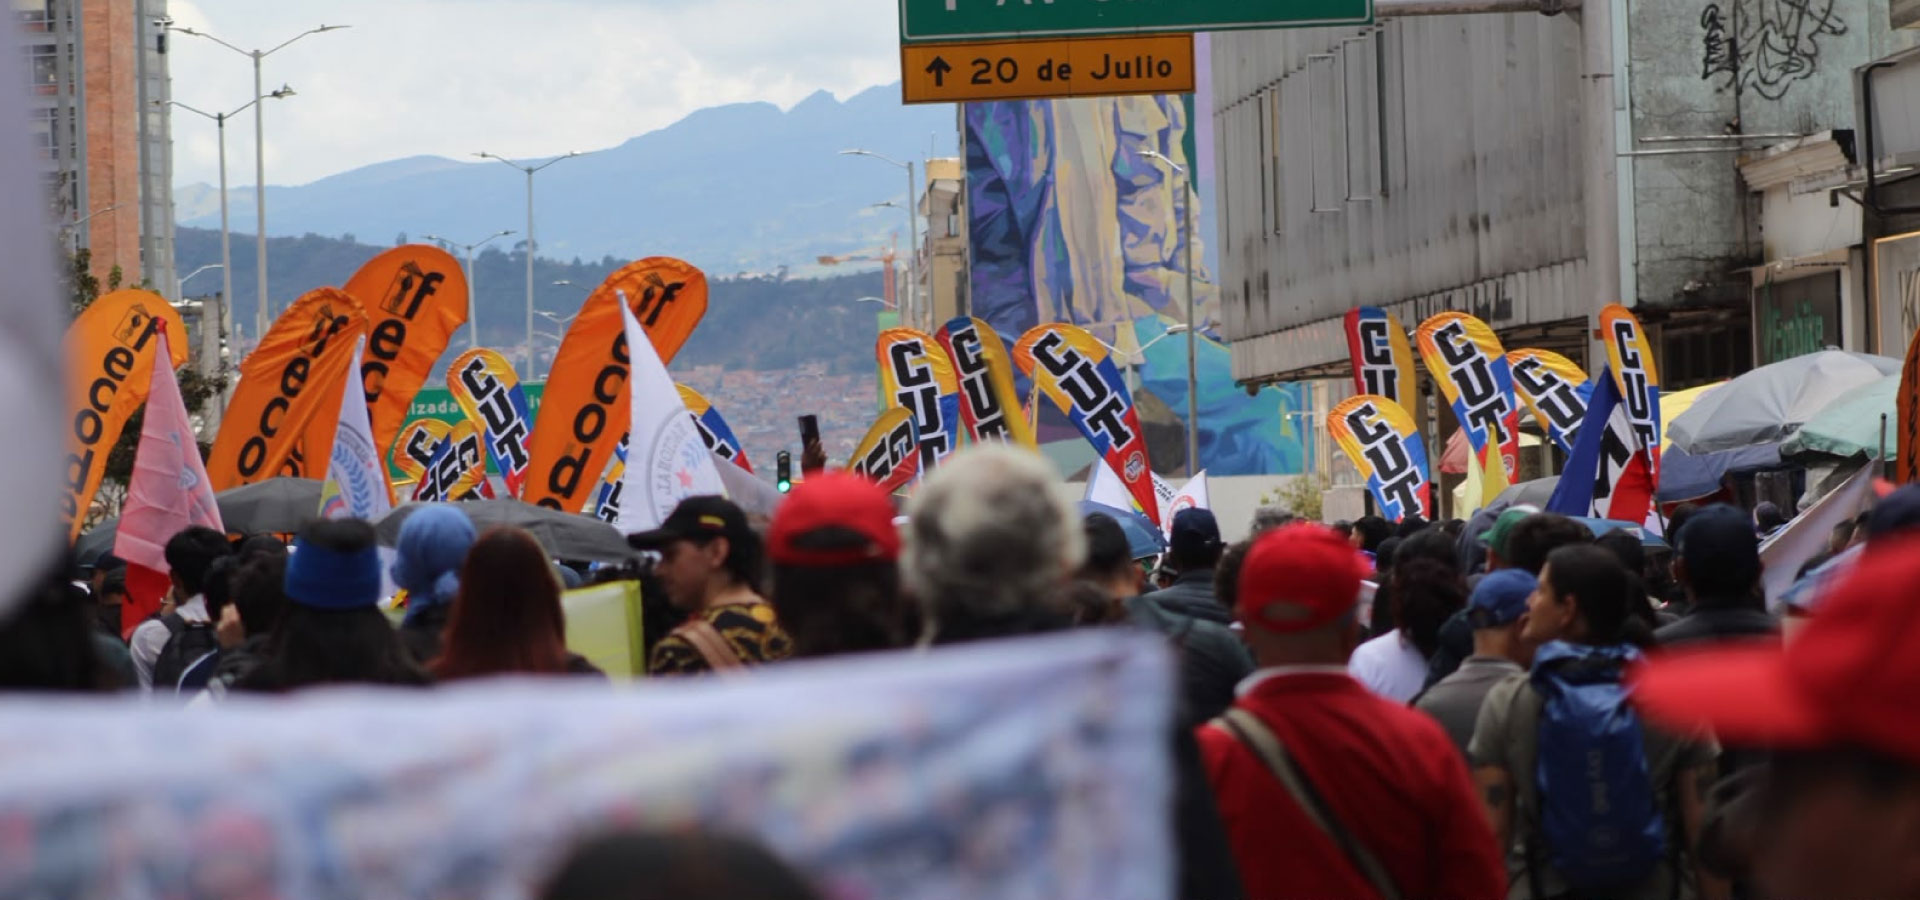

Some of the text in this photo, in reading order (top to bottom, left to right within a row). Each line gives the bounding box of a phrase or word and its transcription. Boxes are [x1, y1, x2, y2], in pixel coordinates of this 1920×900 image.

[970, 53, 1173, 85] 20 de Julio
[1031, 330, 1135, 450] CUT
[1360, 320, 1398, 401] CU
[1433, 320, 1510, 444] CUT
[1511, 356, 1588, 449] CU
[460, 356, 530, 474] CUT
[854, 420, 915, 481] CU
[1346, 402, 1424, 516] CUT
